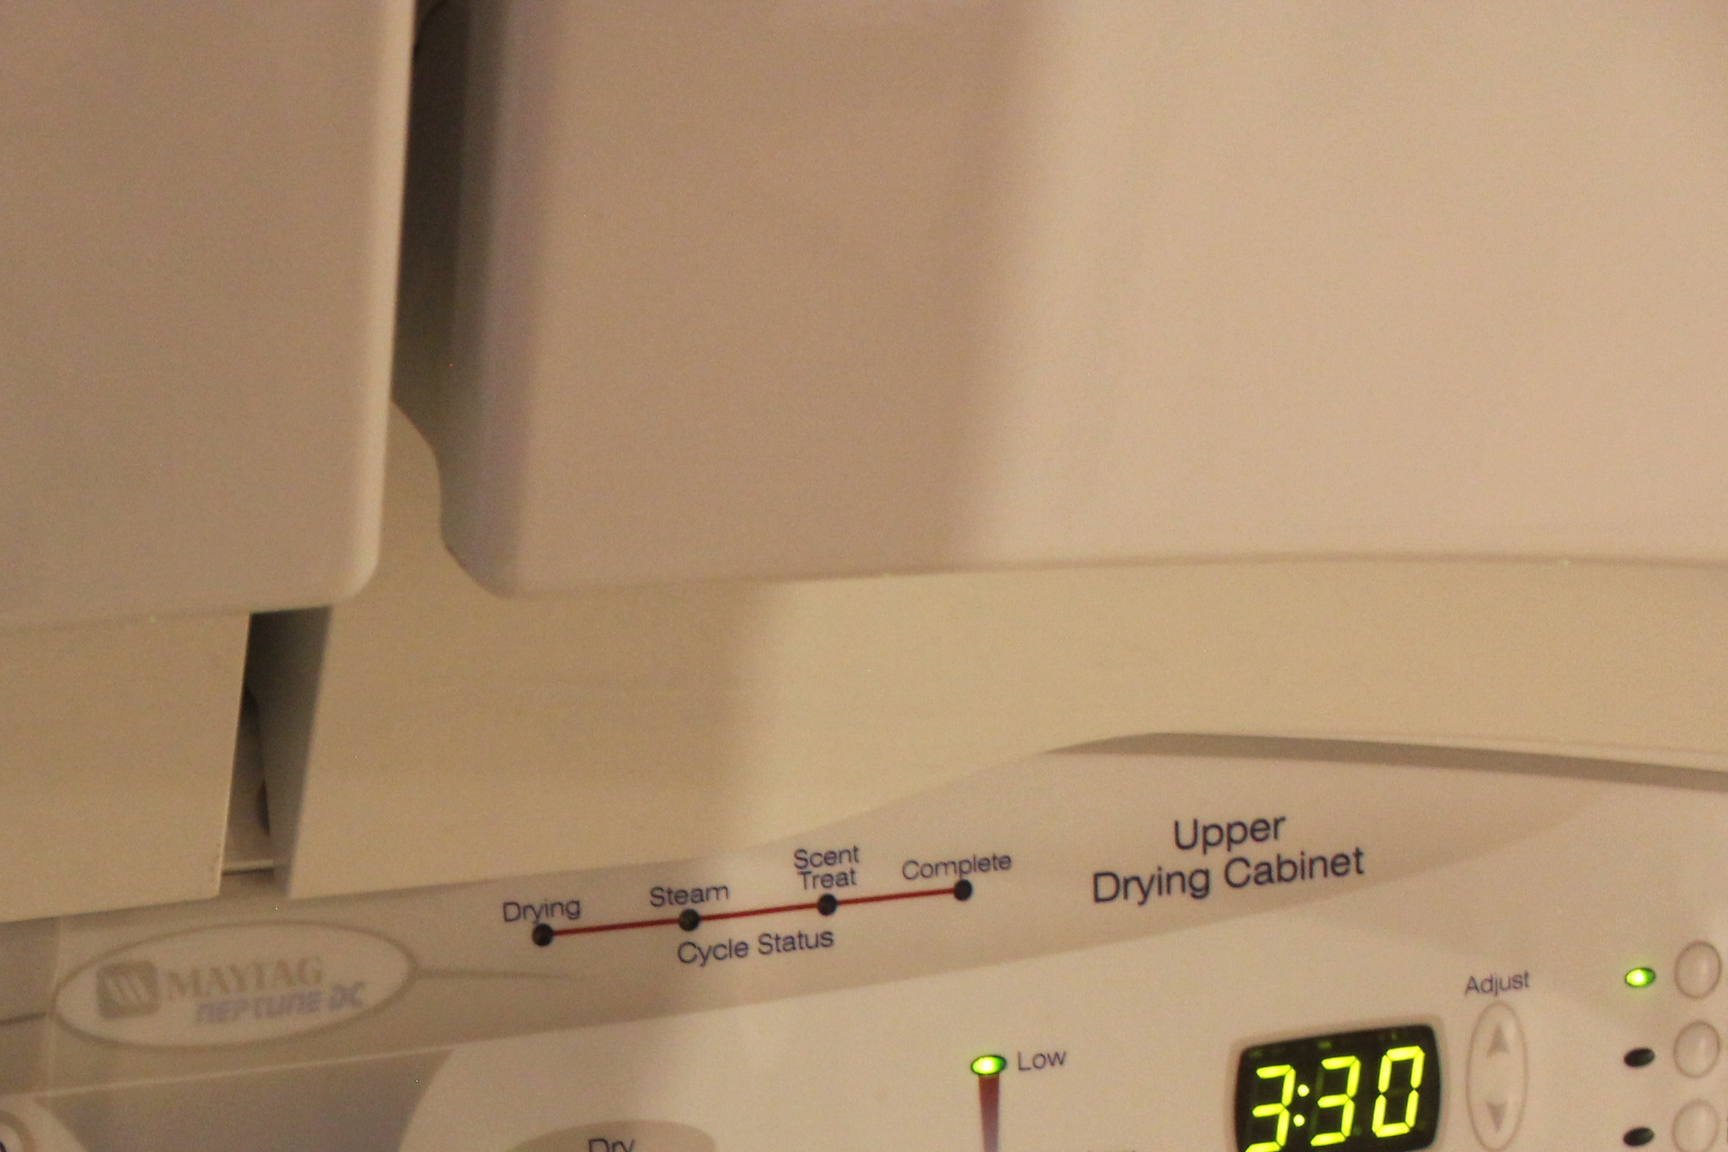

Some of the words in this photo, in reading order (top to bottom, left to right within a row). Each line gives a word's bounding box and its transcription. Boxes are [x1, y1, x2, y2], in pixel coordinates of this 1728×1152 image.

[1172, 815, 1287, 856] Upper
[793, 846, 860, 870] Scent
[901, 852, 1013, 882] Complete
[800, 867, 857, 892] Treat
[1092, 866, 1212, 906] Drying
[1223, 846, 1366, 890] Cabinet
[649, 882, 730, 908] Steam
[502, 897, 581, 925] Drying
[677, 937, 750, 968] Cycle
[757, 928, 835, 955] Status
[165, 956, 324, 1000] MAYTAG
[1464, 969, 1531, 997] Adjust
[1017, 1050, 1067, 1071] Low
